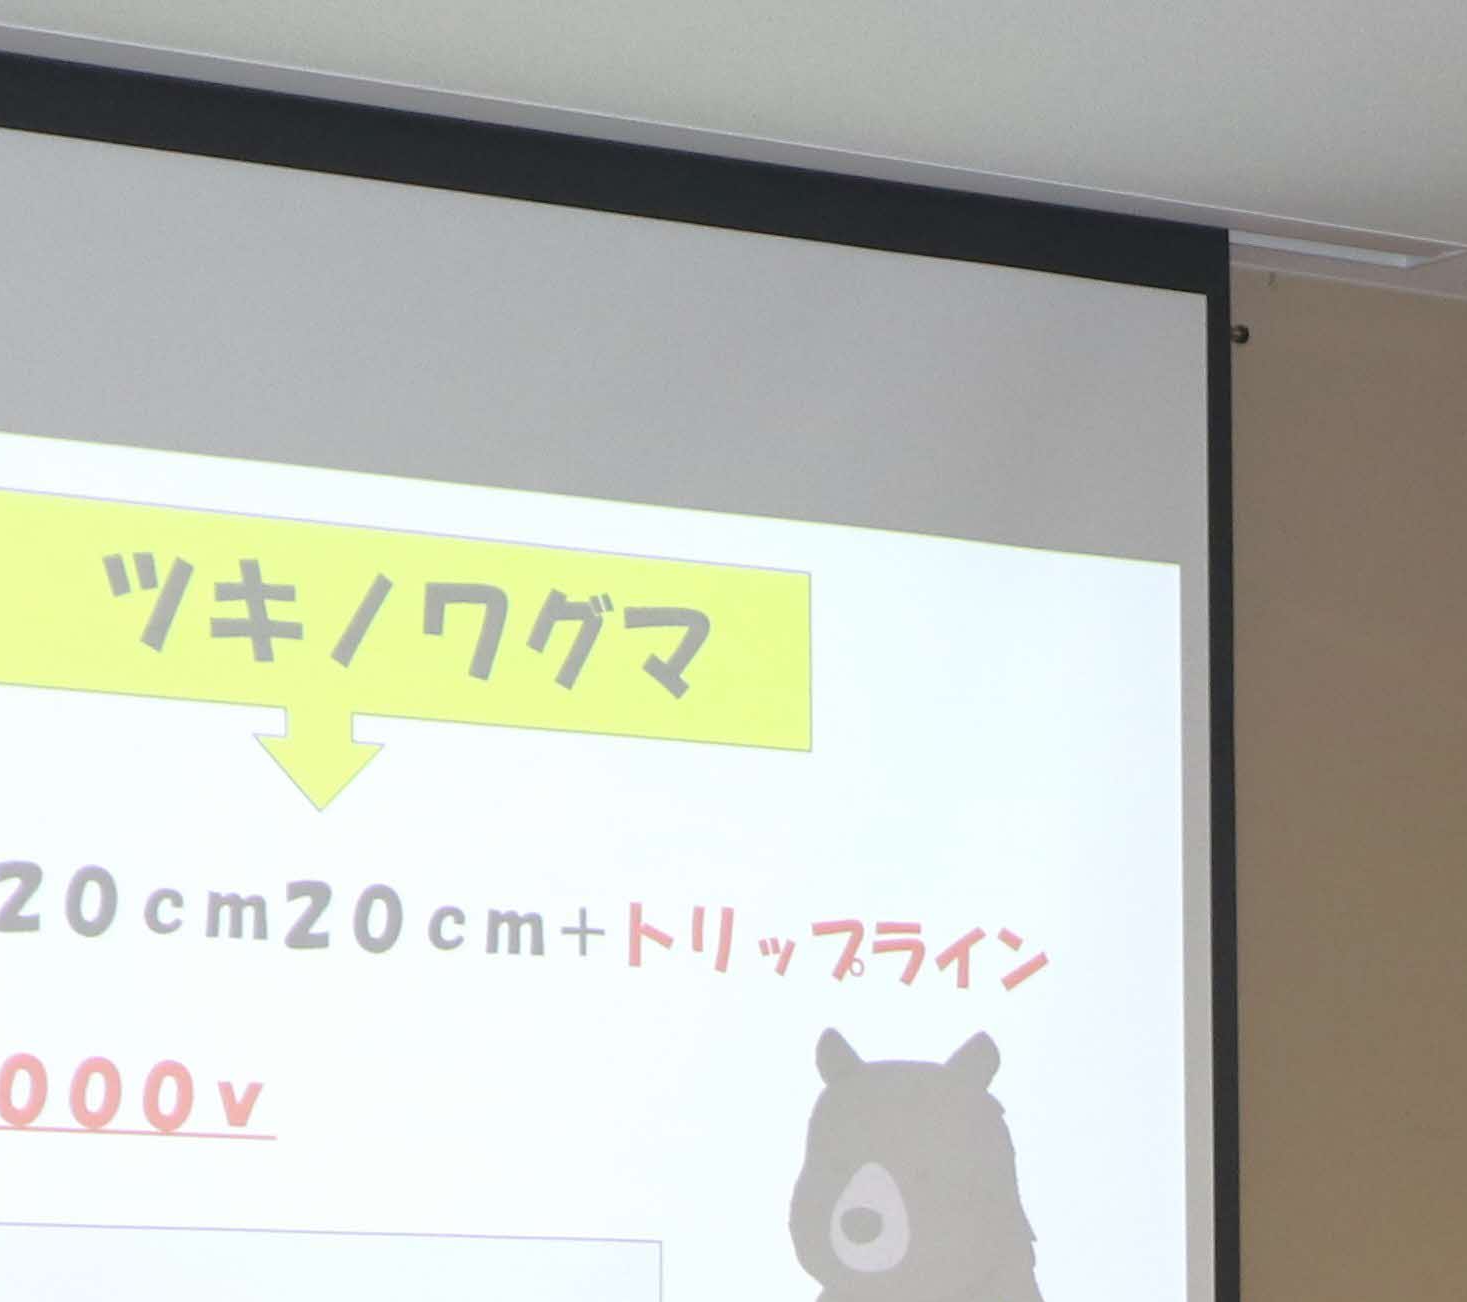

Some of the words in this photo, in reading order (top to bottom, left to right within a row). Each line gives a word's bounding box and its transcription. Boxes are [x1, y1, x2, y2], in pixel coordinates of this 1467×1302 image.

[101, 550, 712, 700] ツキノワグマ
